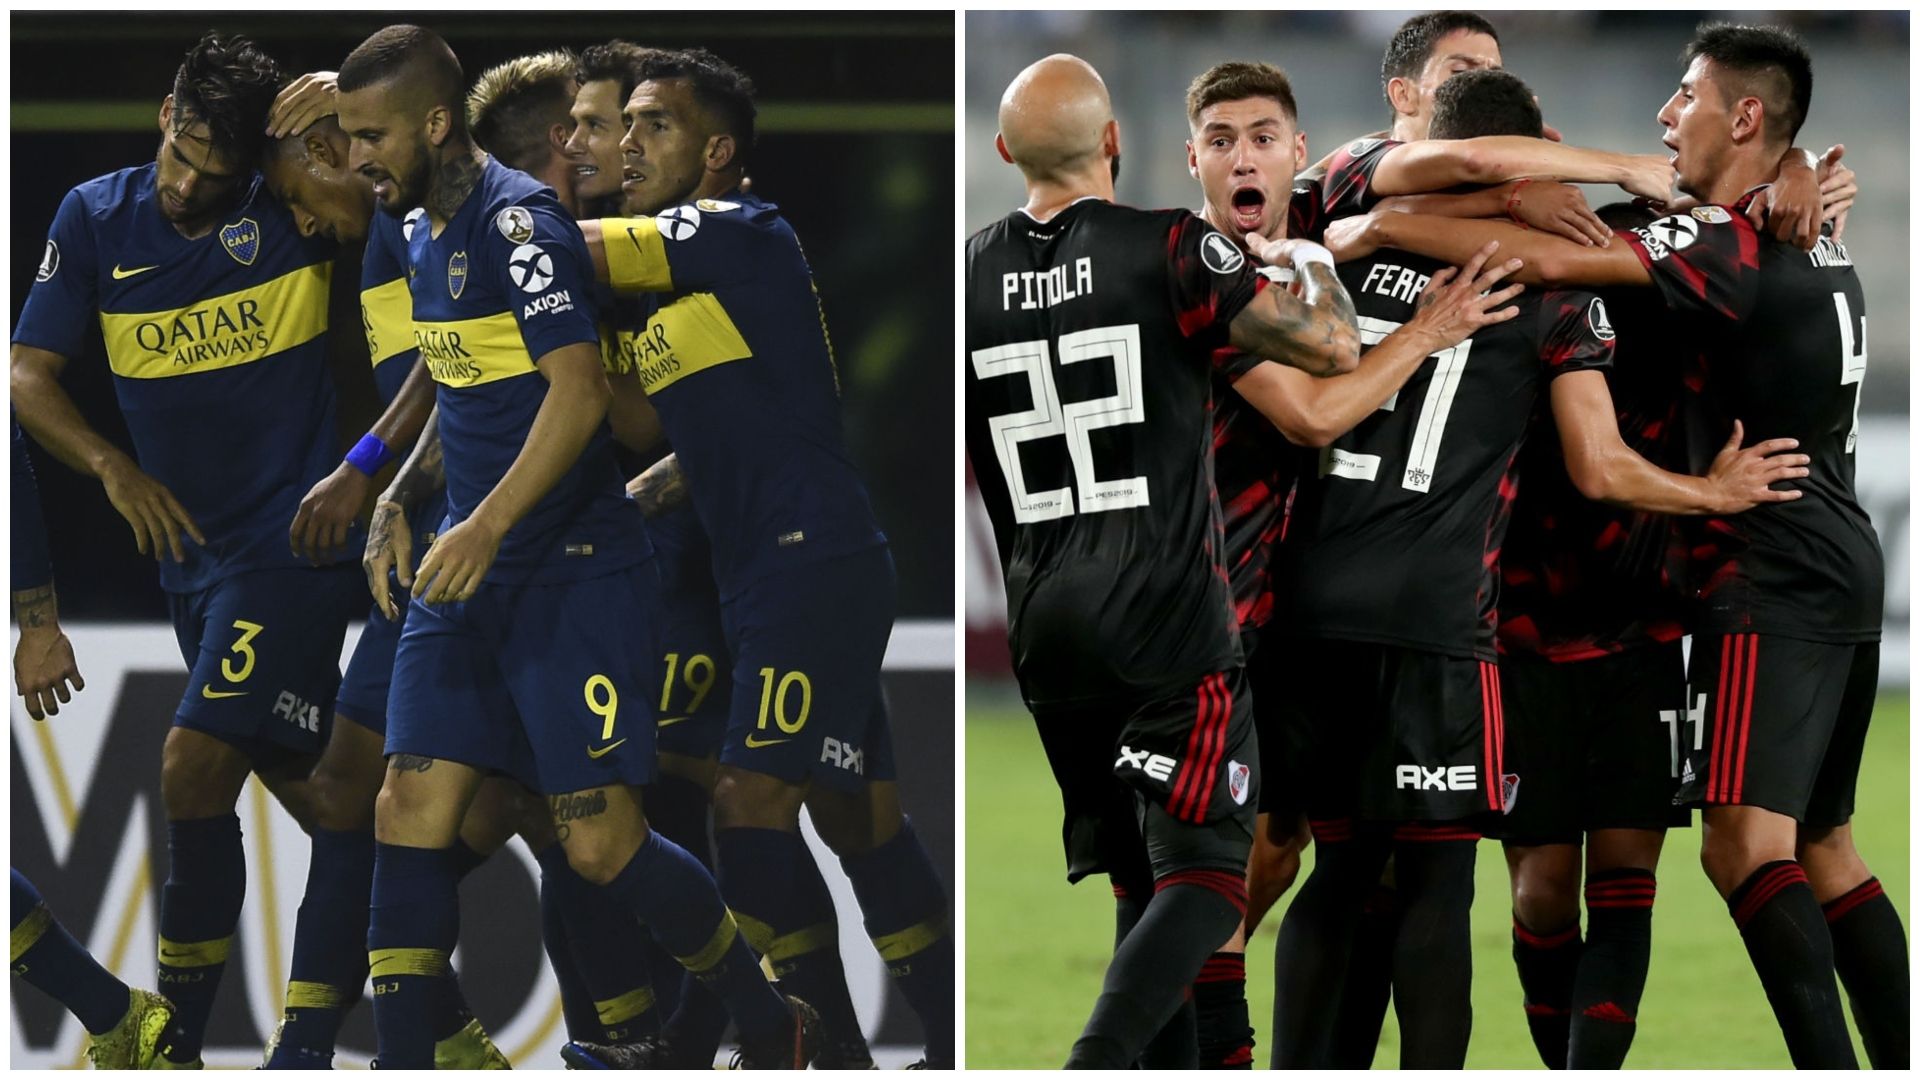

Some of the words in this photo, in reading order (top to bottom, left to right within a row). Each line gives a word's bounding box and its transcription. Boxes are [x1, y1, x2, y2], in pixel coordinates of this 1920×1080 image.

[226, 231, 256, 248] CABJ
[523, 289, 572, 320] AXION
[1002, 256, 1093, 311] PINOLA
[135, 299, 264, 356] QATAR
[173, 329, 270, 367] AIRWAYS
[970, 323, 1150, 525] 22
[221, 619, 265, 683] 3
[583, 673, 619, 741] 9
[659, 652, 716, 715] 19
[756, 667, 812, 735] 10
[820, 736, 863, 776] AX
[1114, 745, 1177, 782] XE
[1396, 764, 1478, 792] AXE
[371, 981, 399, 996] BJ
